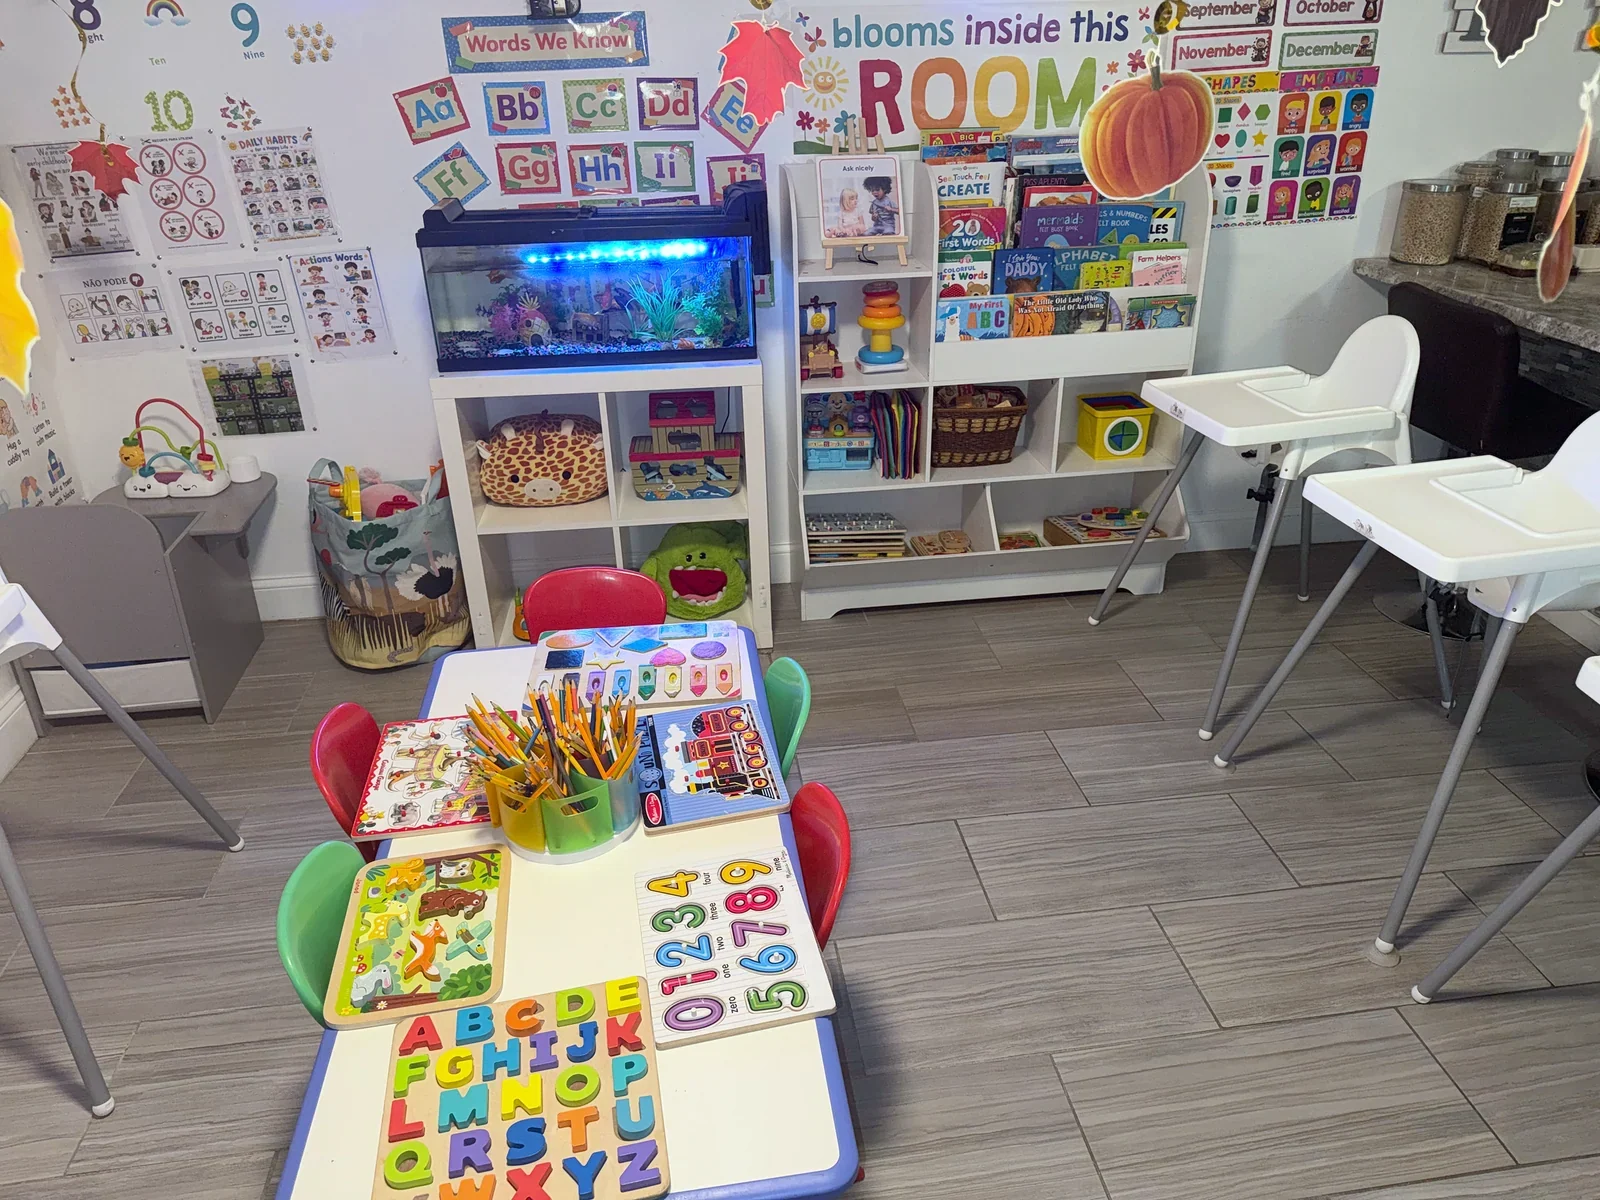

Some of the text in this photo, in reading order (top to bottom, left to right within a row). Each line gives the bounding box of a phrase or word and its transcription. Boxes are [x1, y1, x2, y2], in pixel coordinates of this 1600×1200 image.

[1296, 0, 1355, 14] October
[231, 2, 260, 48] 9
[833, 9, 1129, 48] blooms inside this
[78, 32, 105, 44] Eght
[464, 28, 630, 54] Words We Know
[243, 50, 265, 61] Nine
[1179, 43, 1251, 61] November
[1287, 42, 1358, 57] December
[149, 57, 167, 67] Ten
[1205, 75, 1256, 90] SHAPES
[1296, 69, 1364, 87] EMOTIONS
[576, 92, 617, 119] Cc
[649, 91, 690, 118] Dd
[859, 56, 1097, 137] ROOM
[144, 90, 194, 132] 10
[415, 98, 456, 129] Aa
[497, 93, 539, 122] Bb
[720, 95, 754, 134] Ee
[238, 135, 298, 149] DAILY HABITS
[959, 133, 975, 141] BIG
[27, 155, 68, 168] early childhood
[508, 155, 551, 185] Gg
[579, 154, 622, 182] Hh
[654, 153, 676, 179] Ii
[433, 160, 469, 197] Ff
[938, 183, 991, 198] CREATE
[1037, 212, 1084, 227] mermaids
[1111, 219, 1130, 227] BOOK
[1115, 210, 1149, 223] NUMBERS
[962, 236, 995, 247] Words
[299, 253, 364, 266] Actions Words
[1054, 250, 1117, 266] LPHABET
[1137, 254, 1182, 263] Farm Helpers
[943, 266, 976, 274] COLORFUL
[958, 271, 988, 281] Words
[1005, 261, 1048, 277] DADDY
[1110, 265, 1125, 280] fly
[82, 277, 128, 288] NÃO PODE
[969, 300, 1003, 311] My First
[1018, 306, 1029, 314] Was
[1067, 302, 1076, 310] Of
[1076, 301, 1105, 311] Anything
[1024, 299, 1036, 307] The
[1055, 296, 1067, 304] Old
[1068, 295, 1083, 305] Lady
[1084, 294, 1099, 302] Who
[967, 310, 1005, 329] ABC
[32, 418, 51, 435] Listen to
[44, 428, 56, 441] music
[6, 440, 17, 451] Hug
[7, 447, 31, 467] cuddly toy
[48, 487, 59, 499] Build
[62, 476, 73, 487] tower
[63, 488, 76, 500] blocks
[719, 860, 772, 884] 9
[773, 857, 783, 872] nine
[647, 871, 699, 897] 4
[703, 872, 712, 885] four
[725, 886, 778, 914] 8
[651, 904, 706, 932] 3
[709, 902, 718, 920] three
[731, 921, 787, 947] 7
[656, 934, 712, 967] 2
[739, 944, 796, 973] 6
[722, 963, 731, 978] one
[661, 970, 717, 995] 1
[729, 996, 738, 1013] zero
[746, 981, 806, 1011] 5
[399, 976, 642, 1056] A B C D E
[664, 997, 724, 1031] 0
[393, 1011, 643, 1098] F G H I J K
[388, 1053, 648, 1143] L M N O P
[384, 1095, 656, 1190] Q R S T U
[506, 1162, 553, 1200] X
[562, 1150, 608, 1200] Y
[617, 1139, 662, 1193] Z
